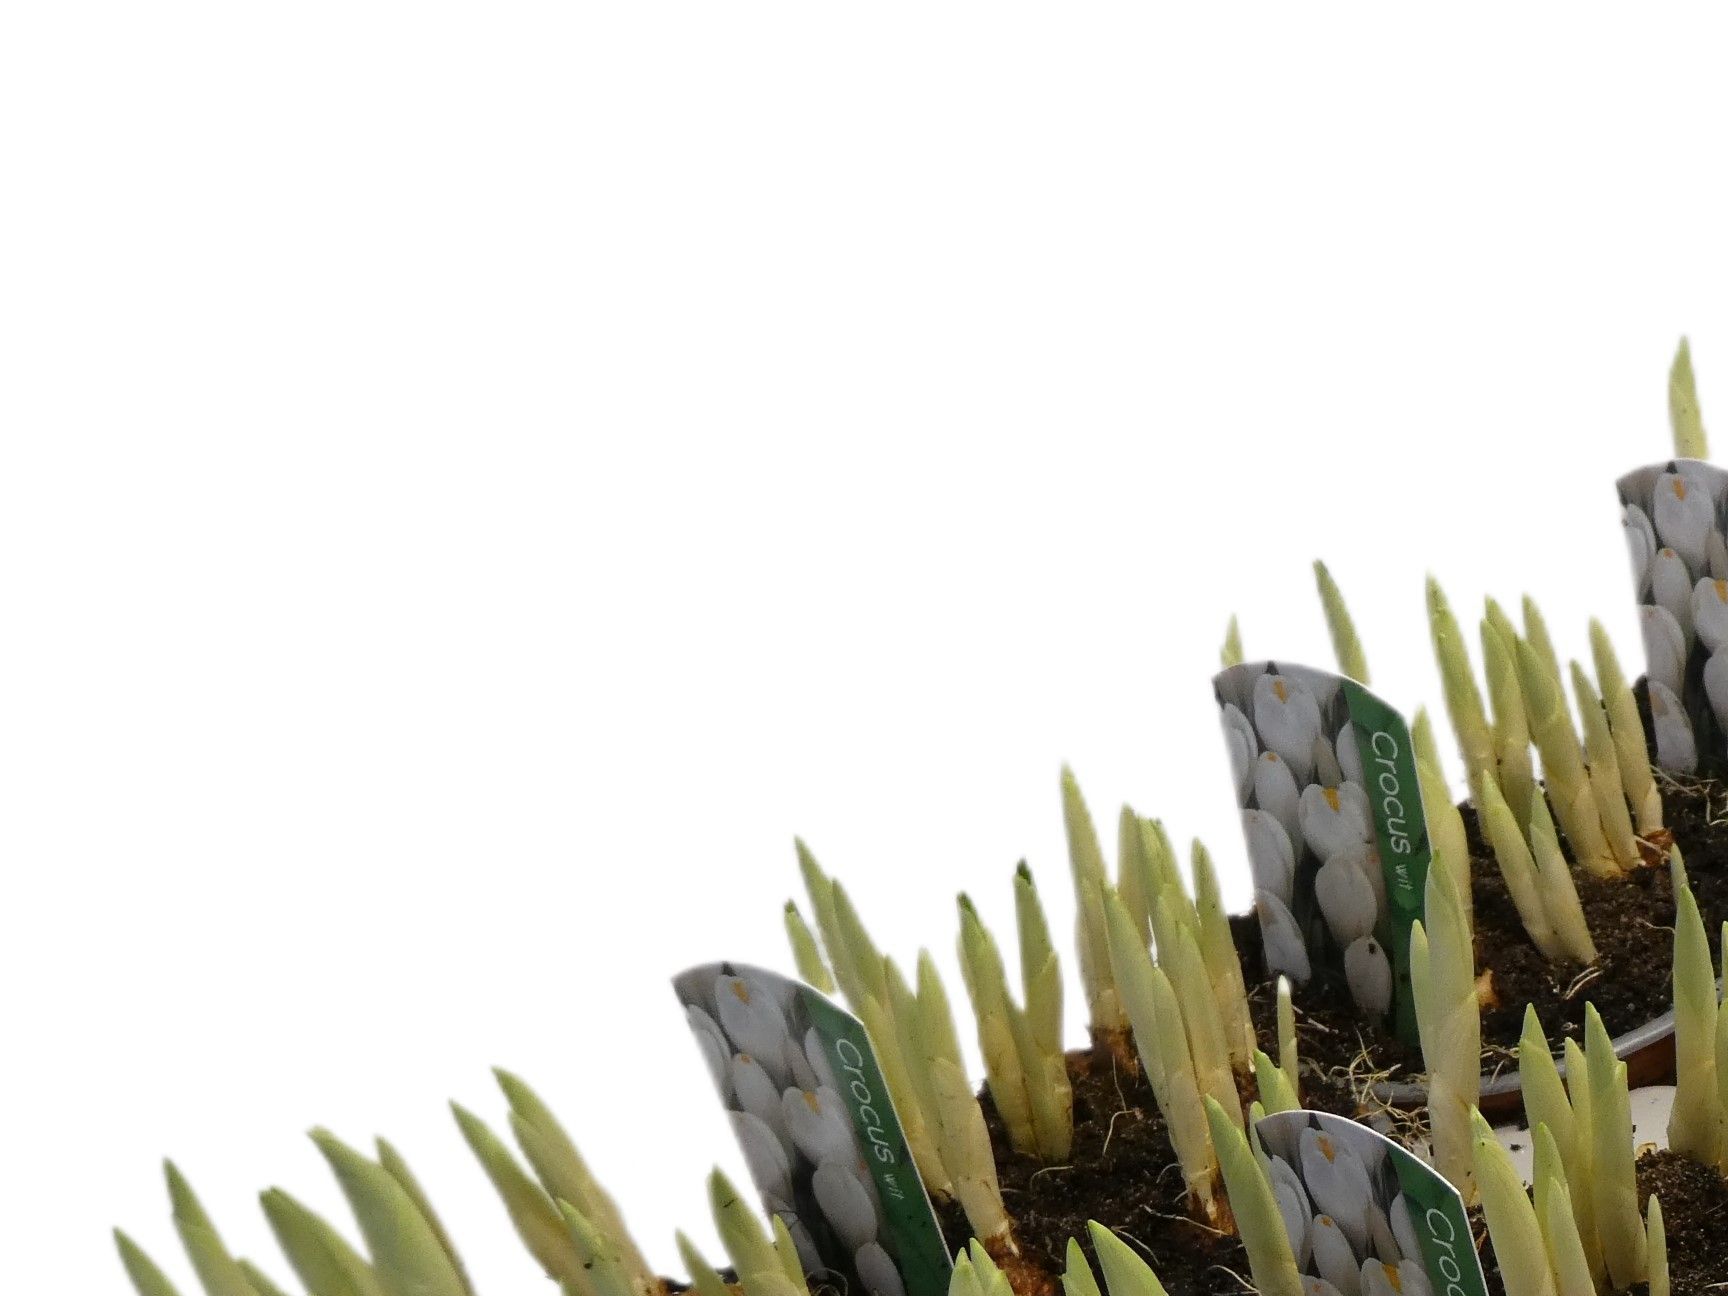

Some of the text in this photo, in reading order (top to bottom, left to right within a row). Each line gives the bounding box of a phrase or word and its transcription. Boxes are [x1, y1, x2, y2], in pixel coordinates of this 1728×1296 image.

[1371, 731, 1414, 891] Crocus wit
[835, 1038, 895, 1165] Crocus
